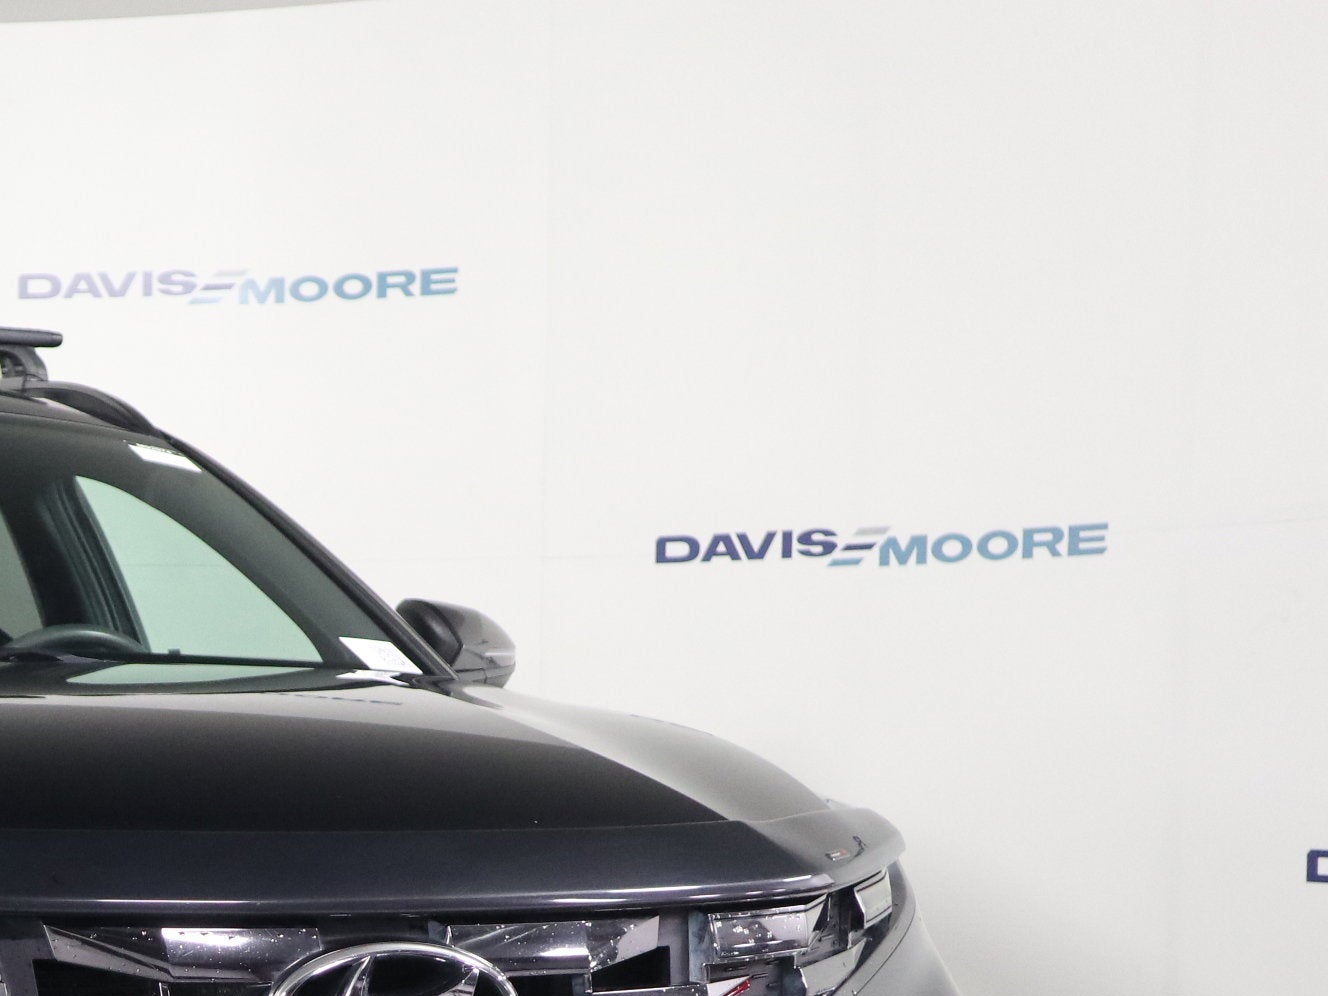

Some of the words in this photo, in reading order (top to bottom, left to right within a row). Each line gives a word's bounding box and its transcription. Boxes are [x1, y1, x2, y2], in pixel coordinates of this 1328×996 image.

[18, 269, 198, 299] DAVIS
[239, 267, 459, 304] MOORE
[655, 529, 838, 563] DAVIS
[879, 522, 1109, 567] MOORE
